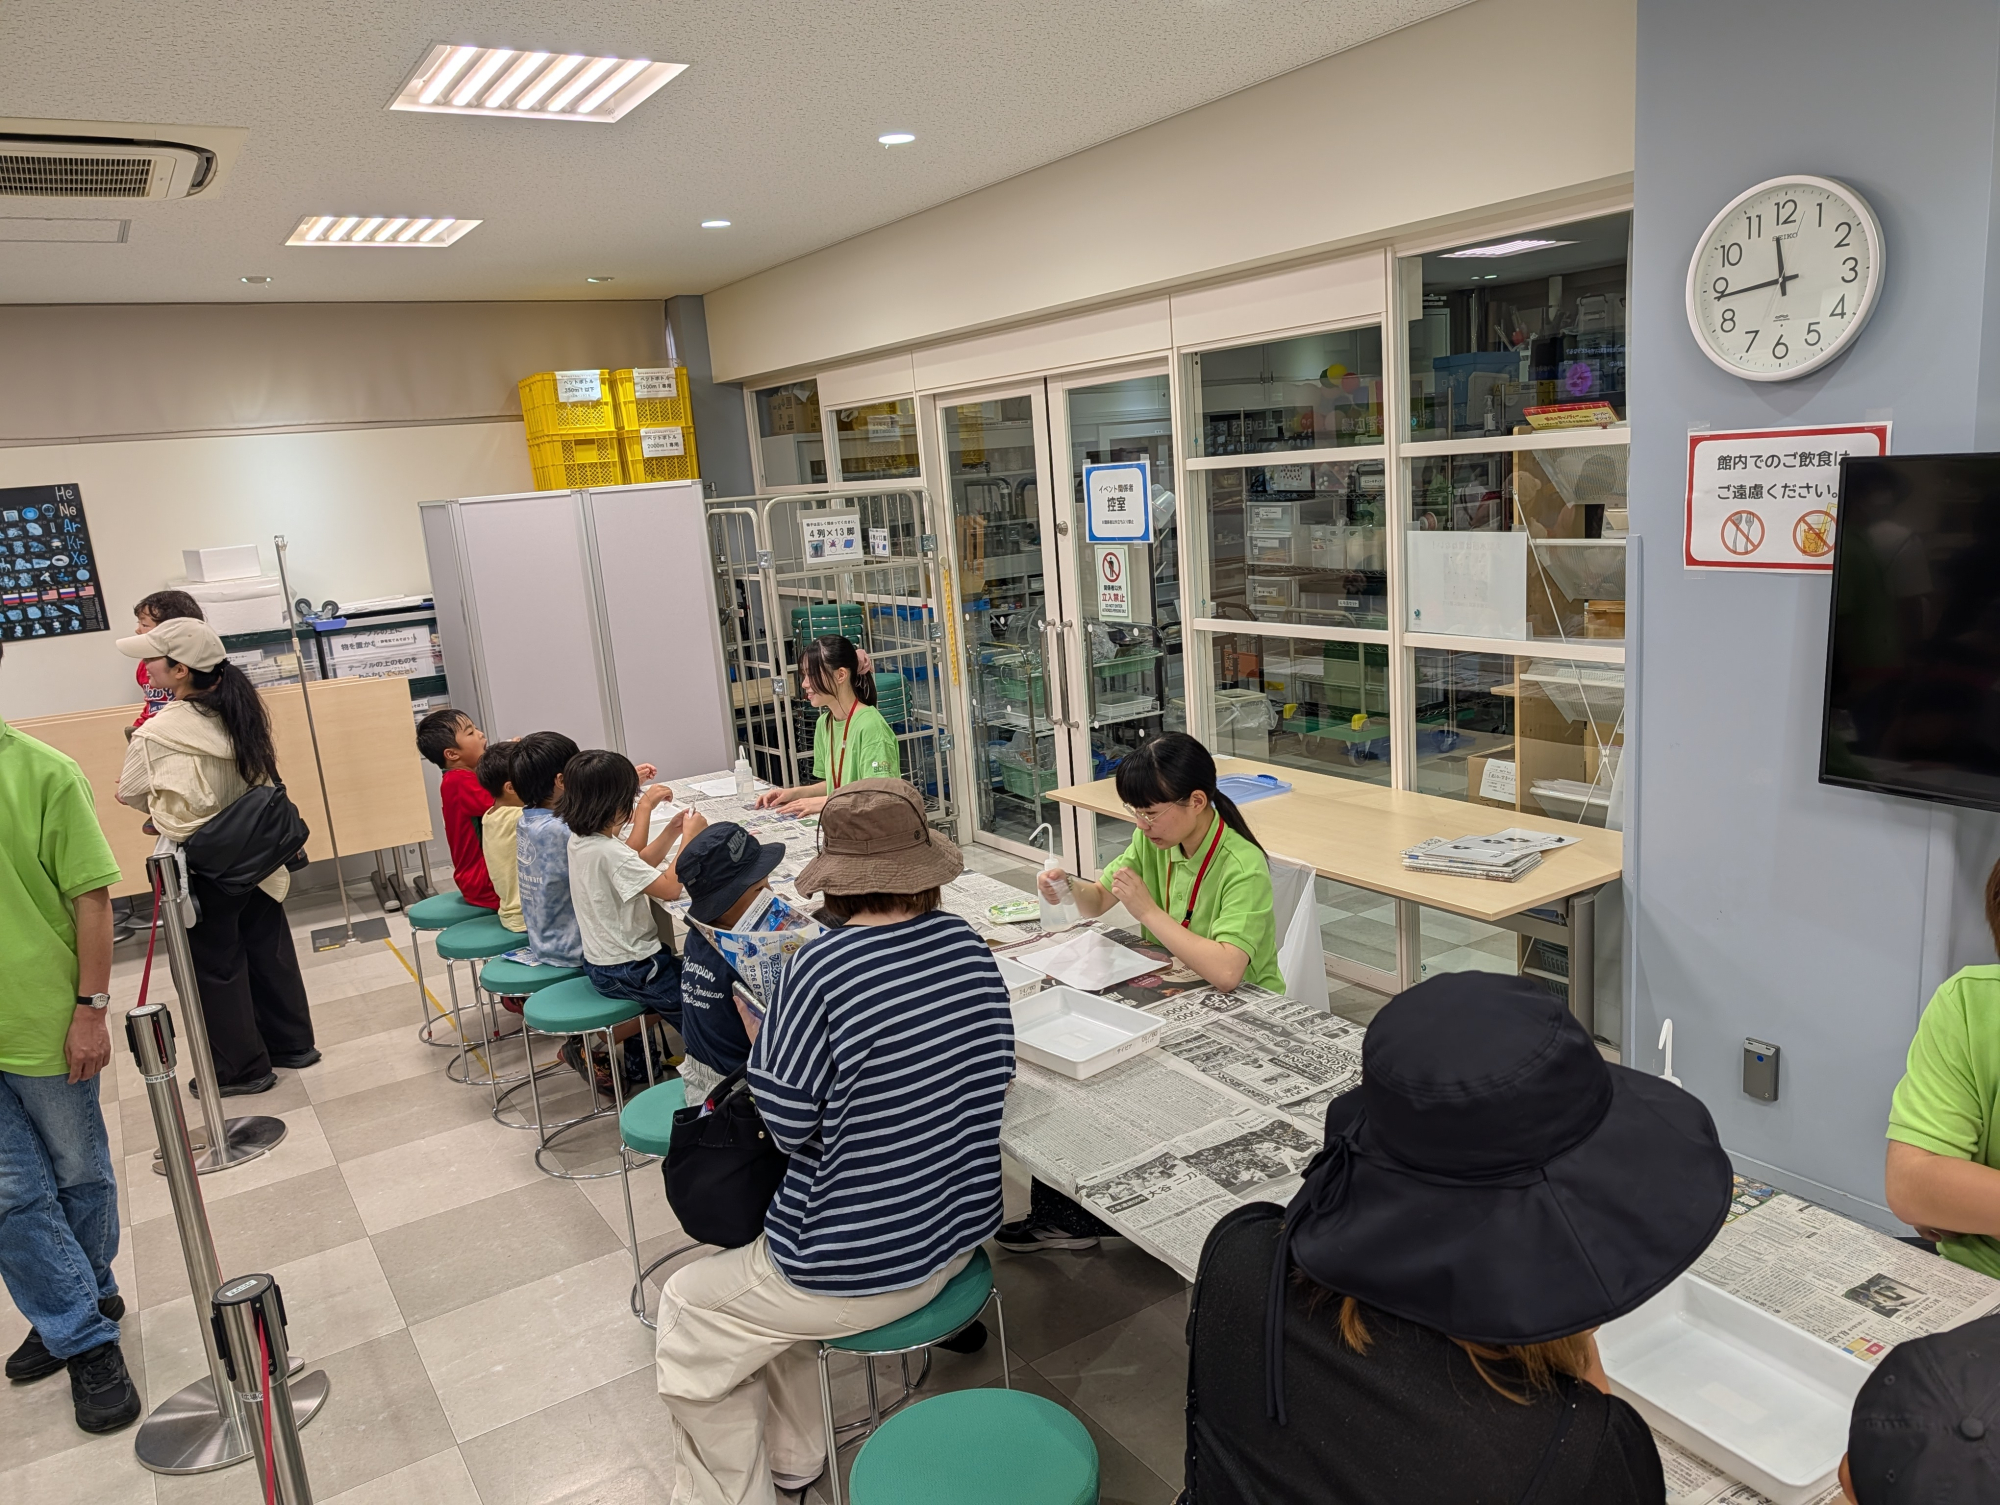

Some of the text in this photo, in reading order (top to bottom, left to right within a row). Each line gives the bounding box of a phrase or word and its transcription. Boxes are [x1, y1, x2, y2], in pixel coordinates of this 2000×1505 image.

[1774, 198, 1798, 227] 12
[1815, 202, 1824, 228] 1
[1746, 214, 1763, 240] 11
[1772, 231, 1799, 242] SEIKO
[1834, 222, 1852, 248] 2
[1720, 242, 1743, 268] 10
[1841, 256, 1859, 284] 3
[1712, 276, 1729, 302] 9
[1829, 293, 1847, 320] 4
[1720, 308, 1736, 333] 8
[1744, 329, 1760, 354] 7
[1772, 333, 1789, 360] 6
[1804, 321, 1822, 347] 5
[55, 486, 74, 501] He
[1107, 496, 1127, 512] 控室
[1716, 482, 1839, 502] ご遠慮ください。
[63, 519, 81, 533] Ar
[66, 535, 85, 550] Kr
[71, 551, 89, 565] Xe
[1101, 592, 1126, 602] 立入禁止
[348, 656, 418, 671] テーブルの上のものを
[682, 955, 716, 982] Champion
[1147, 1183, 1173, 1199] 大谷
